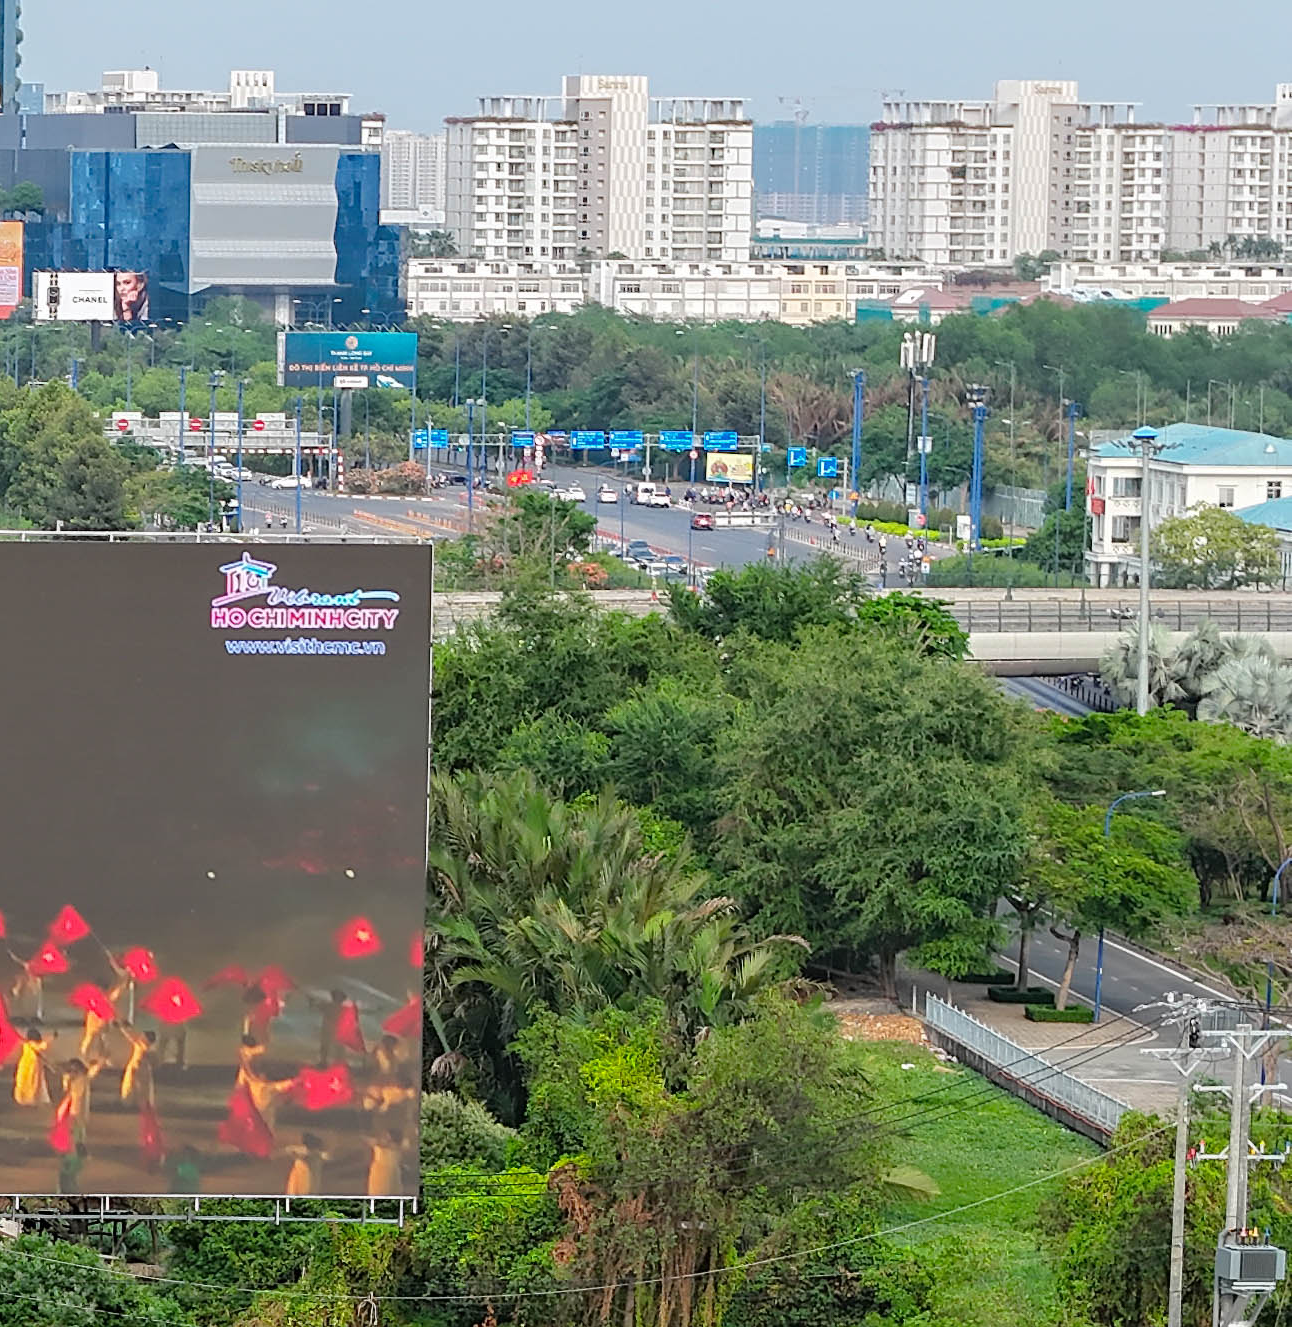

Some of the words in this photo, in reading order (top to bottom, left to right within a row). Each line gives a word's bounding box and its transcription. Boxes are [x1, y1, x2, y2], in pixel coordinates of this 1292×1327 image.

[72, 296, 108, 304] CHANEL
[211, 608, 246, 629] HO
[247, 608, 286, 629] CHI
[287, 608, 343, 629] MINH
[344, 608, 400, 629] CITY
[225, 637, 386, 655] www.visithcmc.vn
